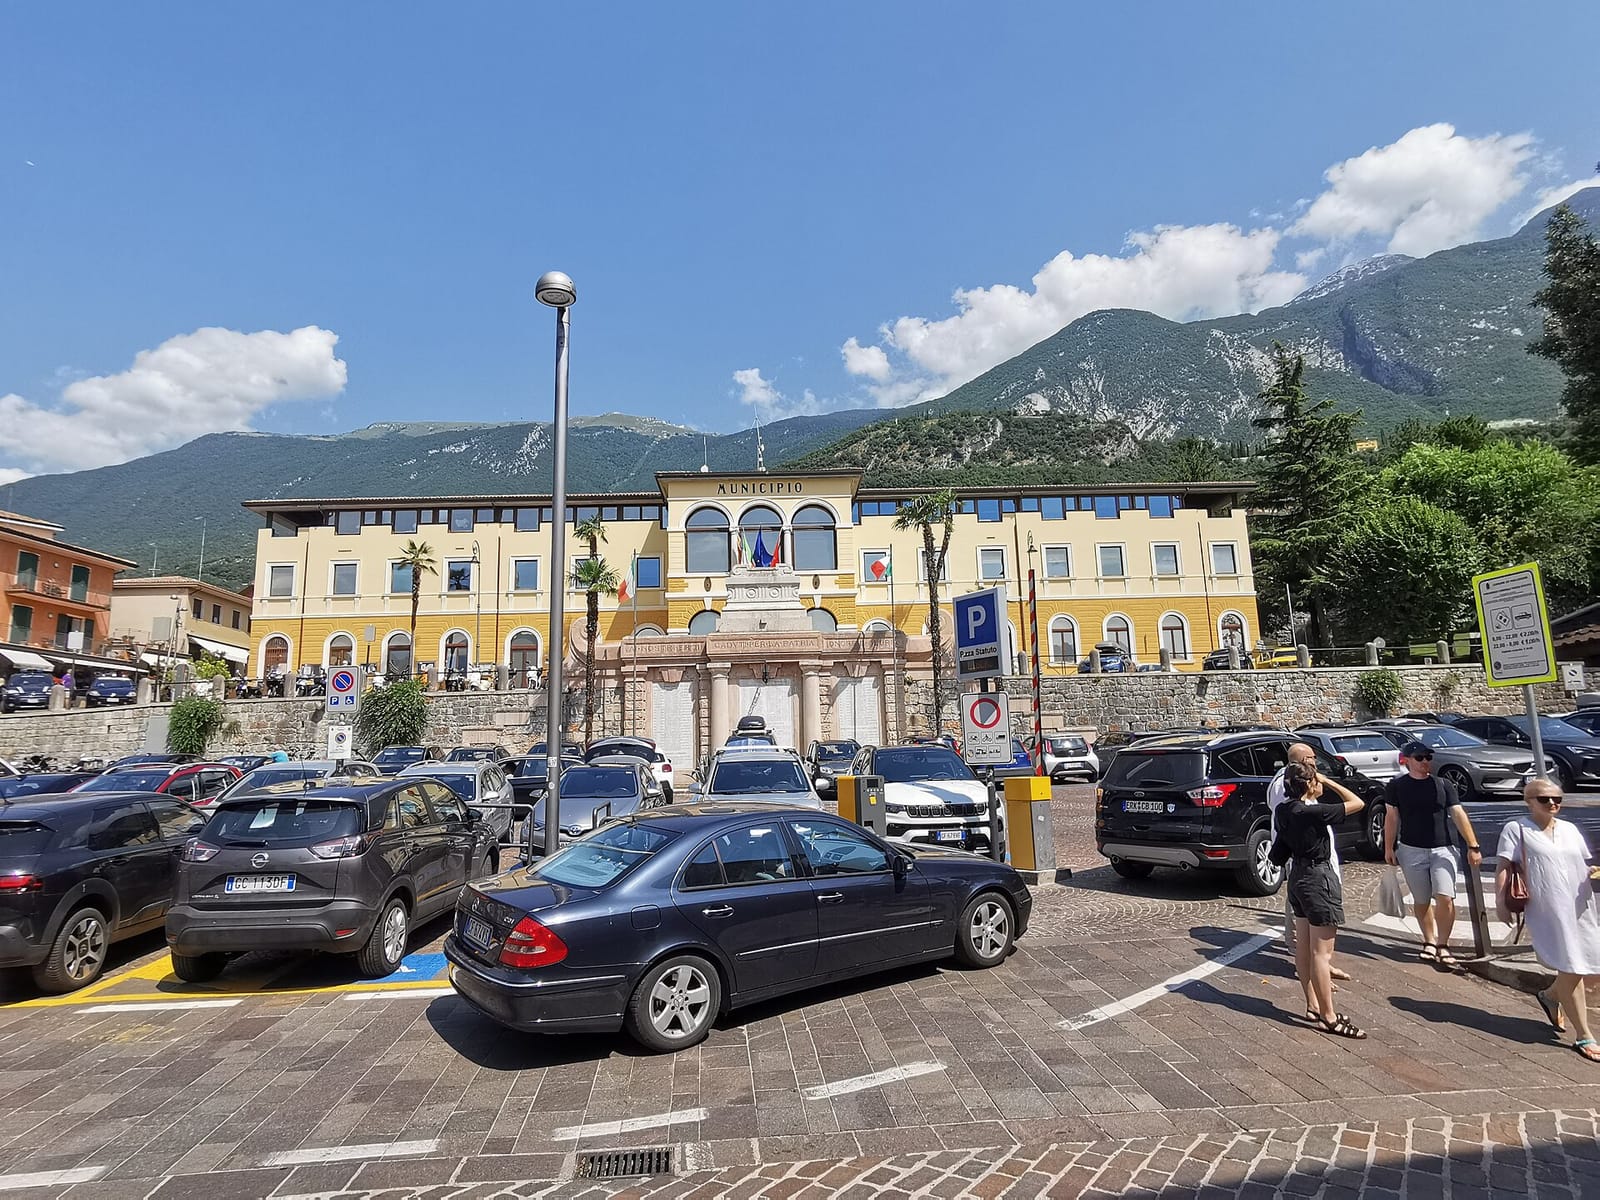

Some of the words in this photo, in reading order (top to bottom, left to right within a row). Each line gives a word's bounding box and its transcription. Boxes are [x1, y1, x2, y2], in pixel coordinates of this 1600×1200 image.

[717, 482, 803, 494] MUNICIPIO
[967, 605, 987, 640] P
[975, 646, 997, 656] Statuto
[252, 876, 288, 889] 113DF
